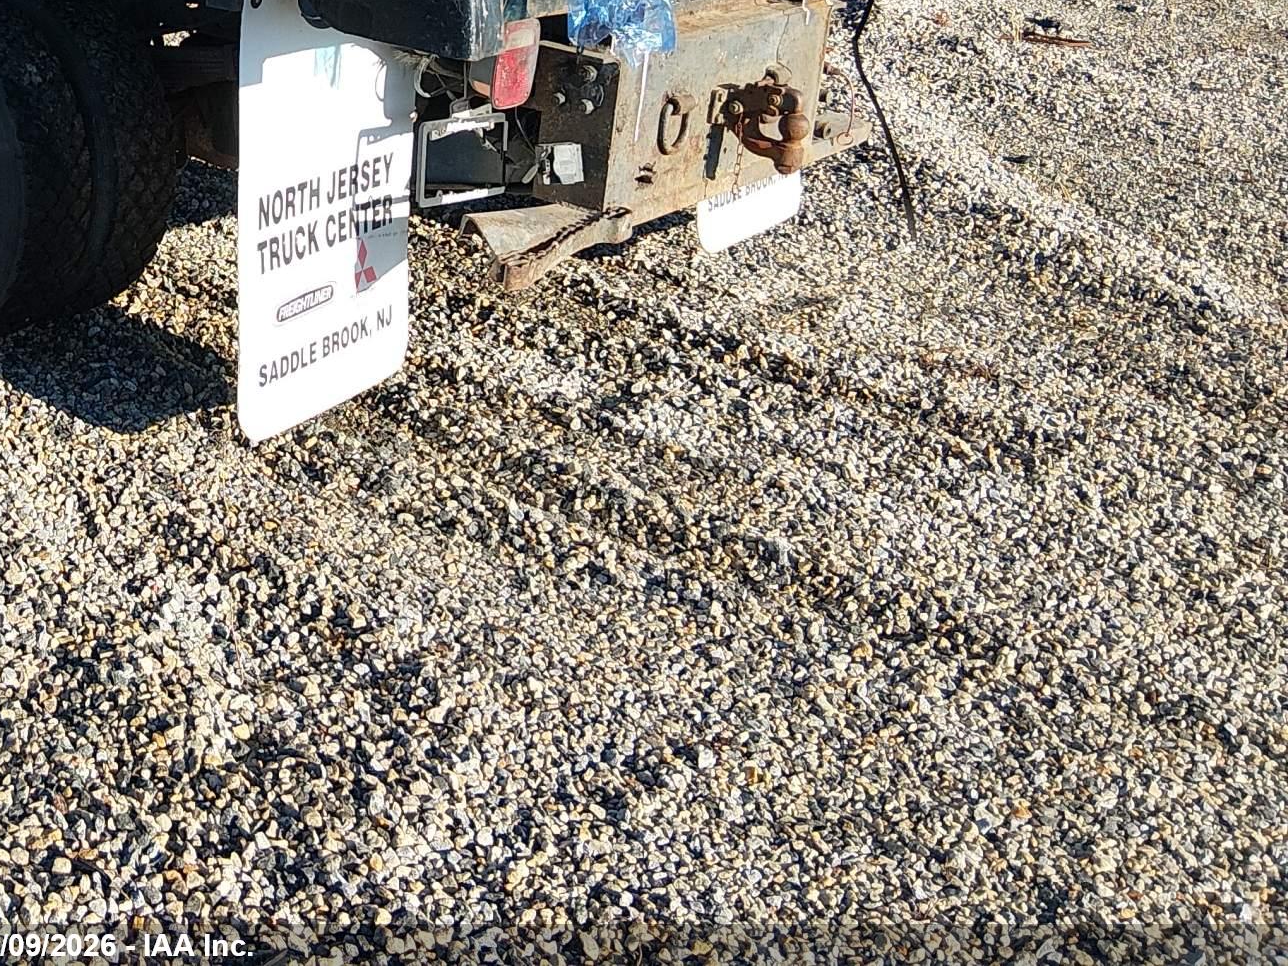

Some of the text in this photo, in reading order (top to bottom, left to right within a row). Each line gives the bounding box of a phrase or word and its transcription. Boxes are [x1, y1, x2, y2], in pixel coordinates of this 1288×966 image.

[258, 152, 394, 231] NORTH JERSEY
[257, 193, 393, 275] TRUCK CENTER
[278, 285, 333, 322] FREIGHTLINER
[258, 304, 393, 388] SADDLE BROOK, NJ
